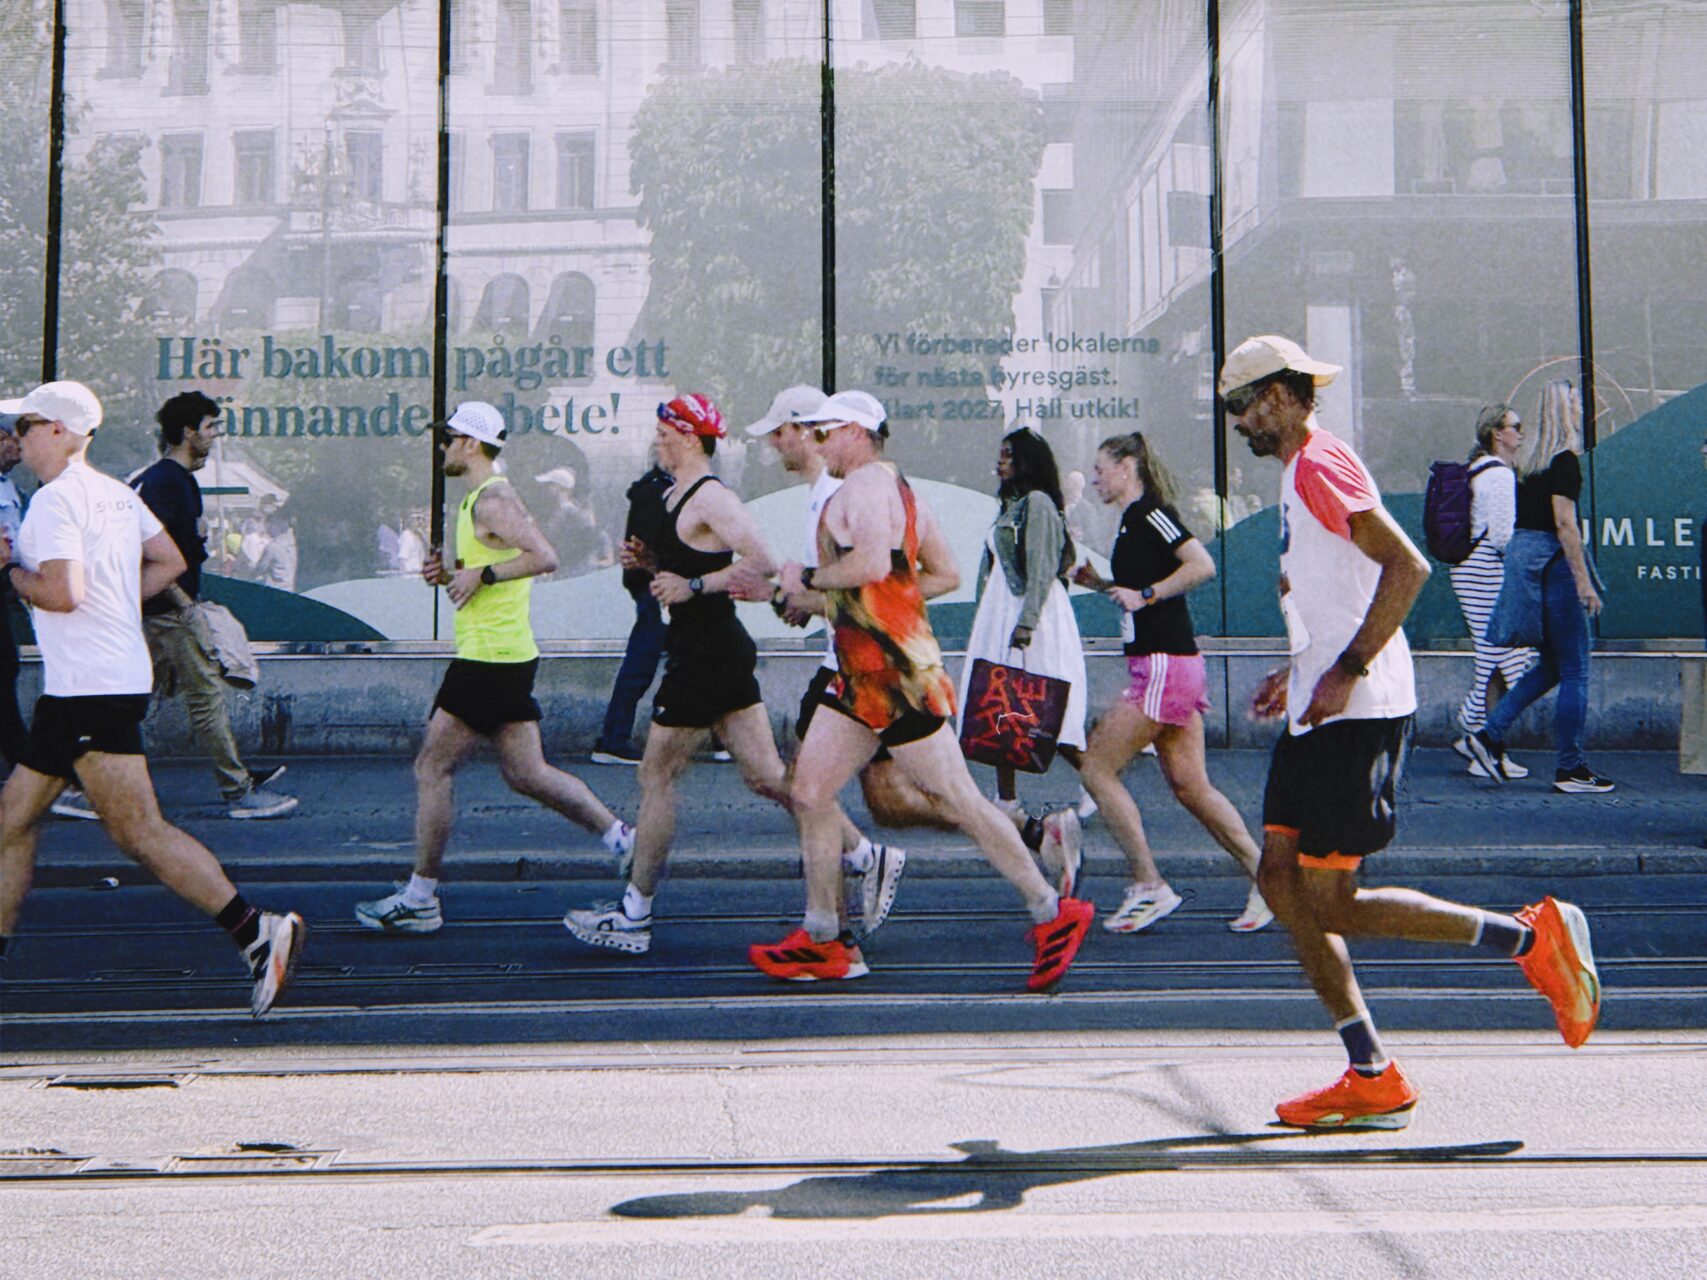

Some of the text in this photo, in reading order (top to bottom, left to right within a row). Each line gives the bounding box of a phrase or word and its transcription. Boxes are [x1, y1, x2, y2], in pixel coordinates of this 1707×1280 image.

[874, 331, 1160, 355] Vi förbereder lokalerna
[156, 335, 669, 391] Här bakom pågår ett
[874, 365, 1118, 391] för nästa hyresgäst.
[215, 392, 621, 438] ännande bete!
[1015, 396, 1062, 419] Håll
[1070, 397, 1139, 419] utkik!
